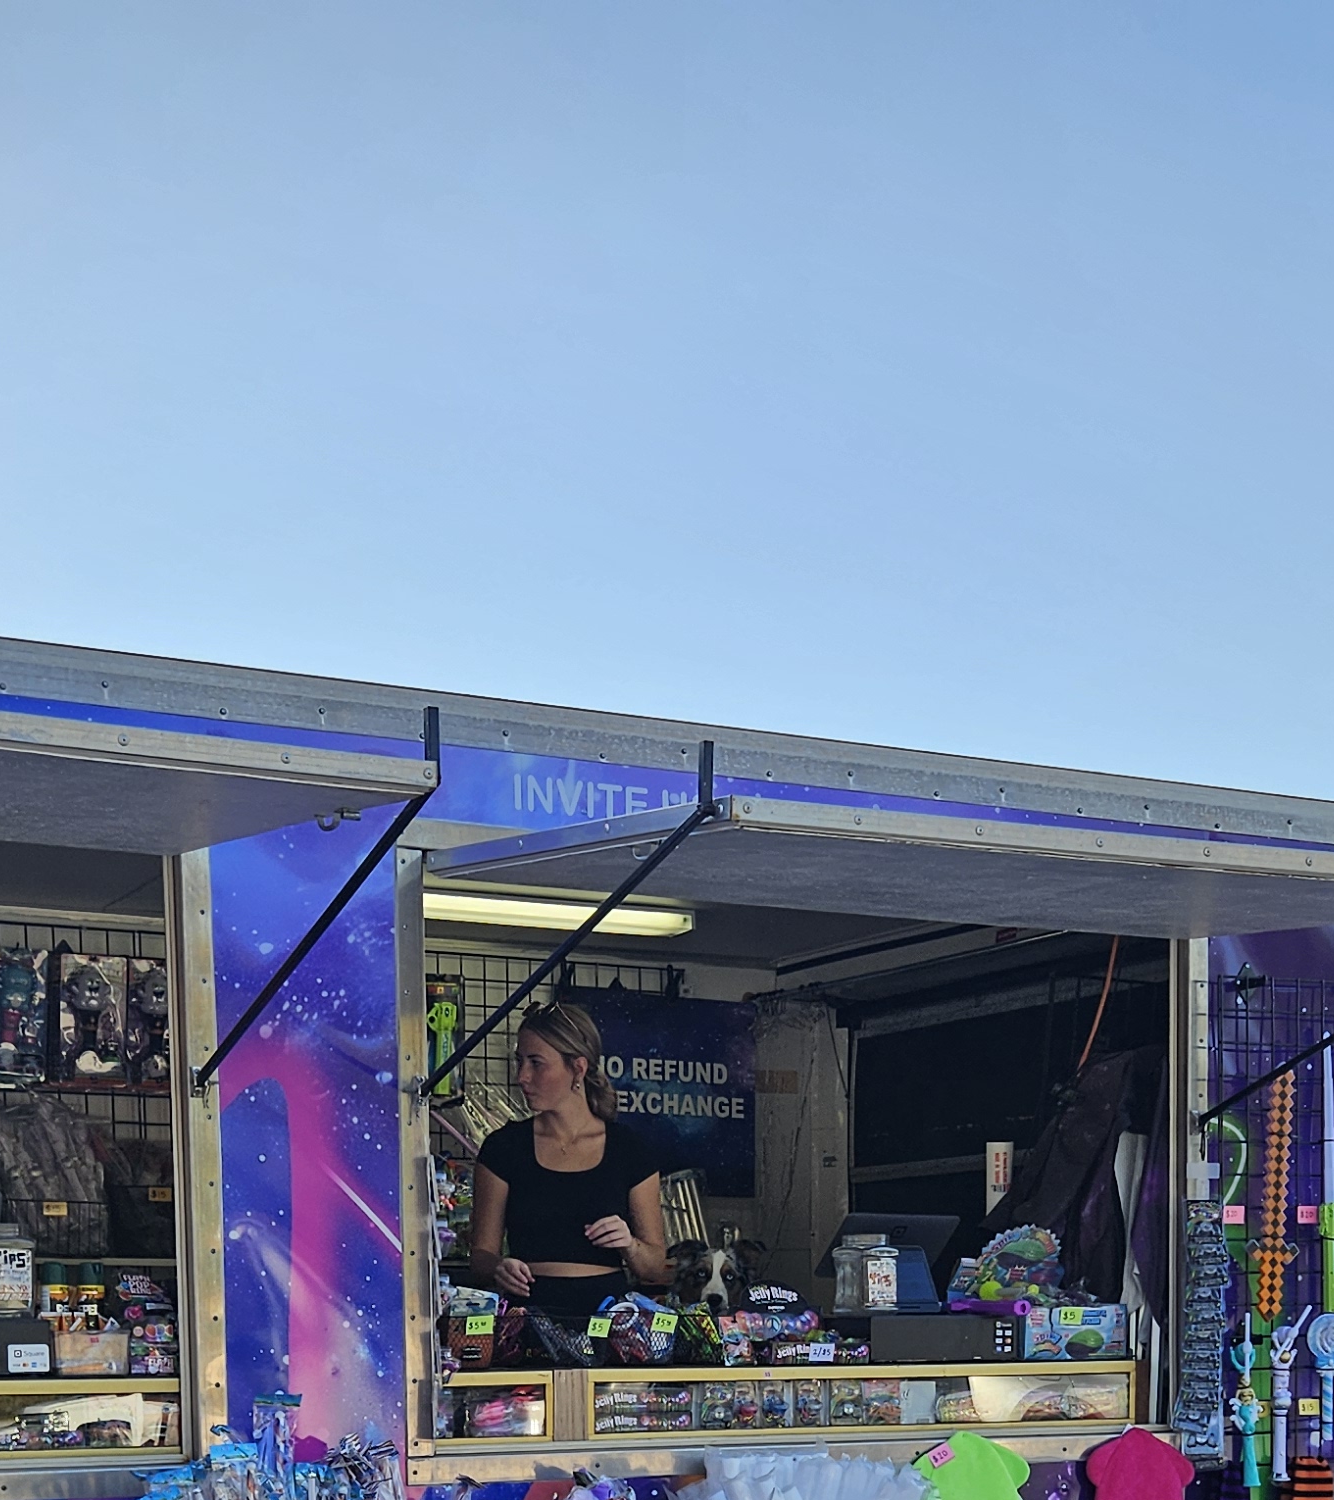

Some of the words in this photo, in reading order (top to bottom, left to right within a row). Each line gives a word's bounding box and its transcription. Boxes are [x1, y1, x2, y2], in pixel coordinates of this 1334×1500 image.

[514, 773, 648, 819] INVITE
[632, 1058, 728, 1085] REFUND
[618, 1091, 745, 1119] EXCHANGE
[749, 1287, 770, 1301] Jelly
[770, 1286, 798, 1302] Rings
[1063, 1312, 1076, 1320] $5
[591, 1322, 604, 1332] $5
[776, 1346, 796, 1359] Jelly
[812, 1347, 831, 1358] 2/$5
[595, 1396, 613, 1408] Jelly
[613, 1392, 637, 1404] Rings
[595, 1419, 614, 1431] Jelly
[613, 1415, 637, 1427] Rings
